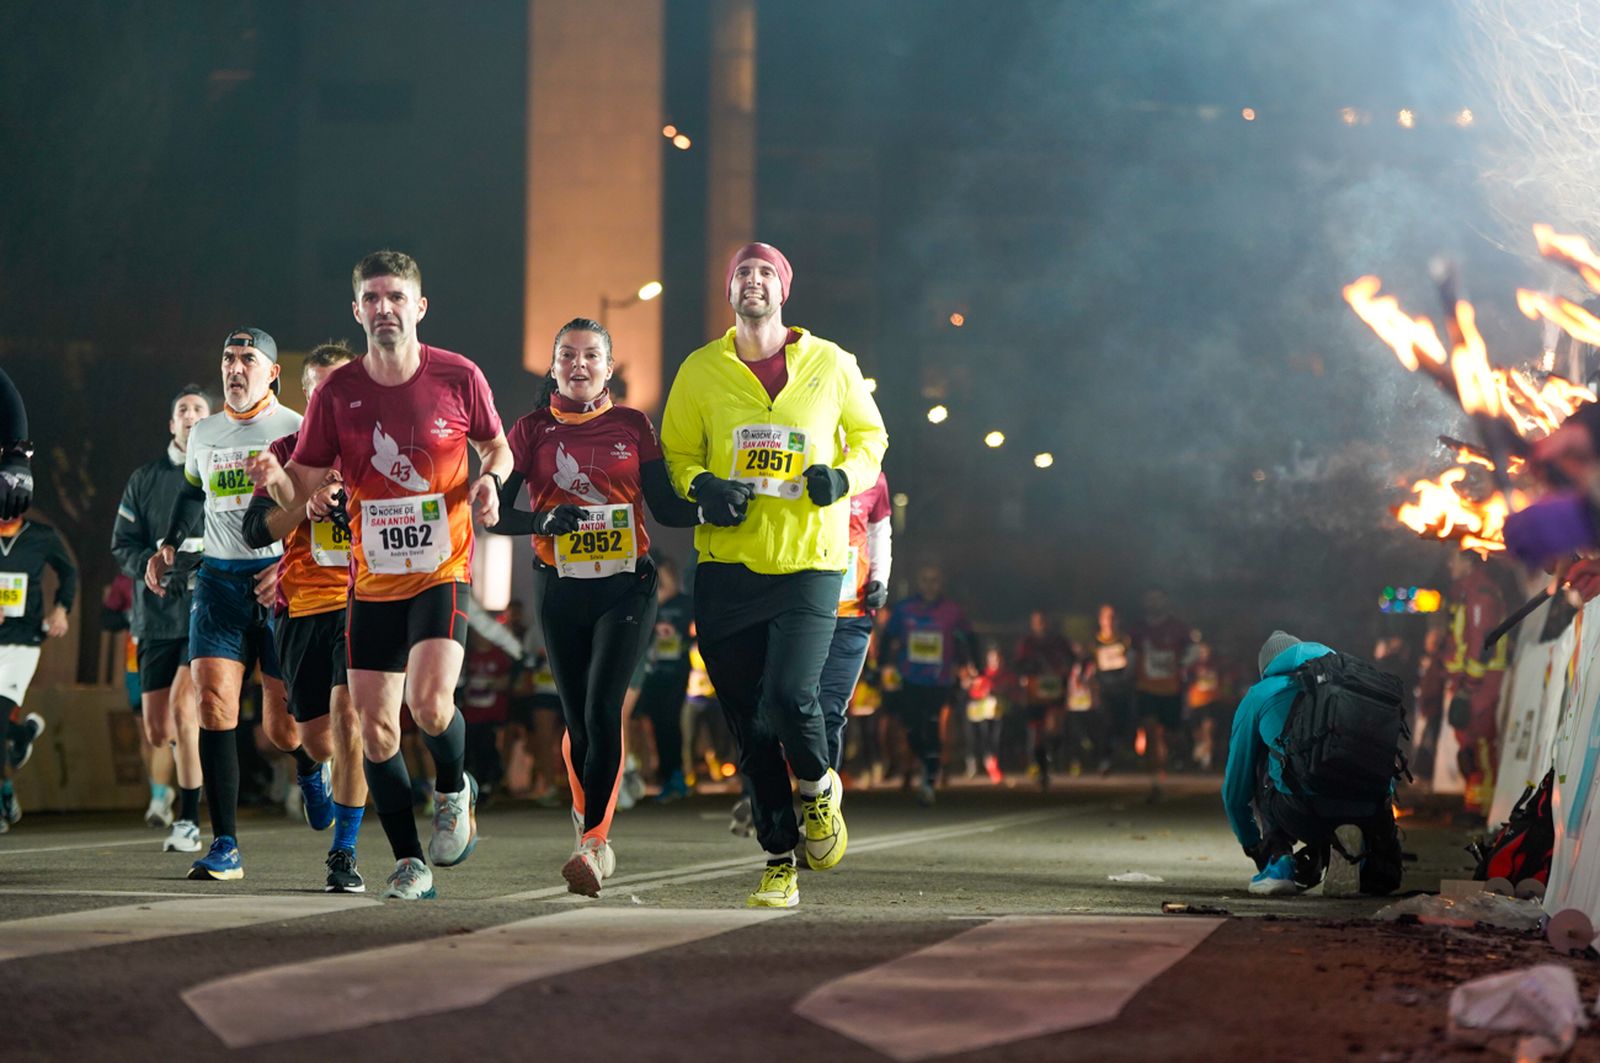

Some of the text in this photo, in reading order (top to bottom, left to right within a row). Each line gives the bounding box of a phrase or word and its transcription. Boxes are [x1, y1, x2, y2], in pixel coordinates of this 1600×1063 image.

[742, 441, 756, 449] SAN
[746, 449, 793, 473] 2951
[390, 461, 411, 482] 43
[569, 479, 590, 495] 43
[378, 507, 403, 516] NOCHE
[404, 506, 414, 514] DE
[371, 518, 386, 527] SAN
[379, 524, 432, 550] 1962
[569, 530, 622, 554] 2952
